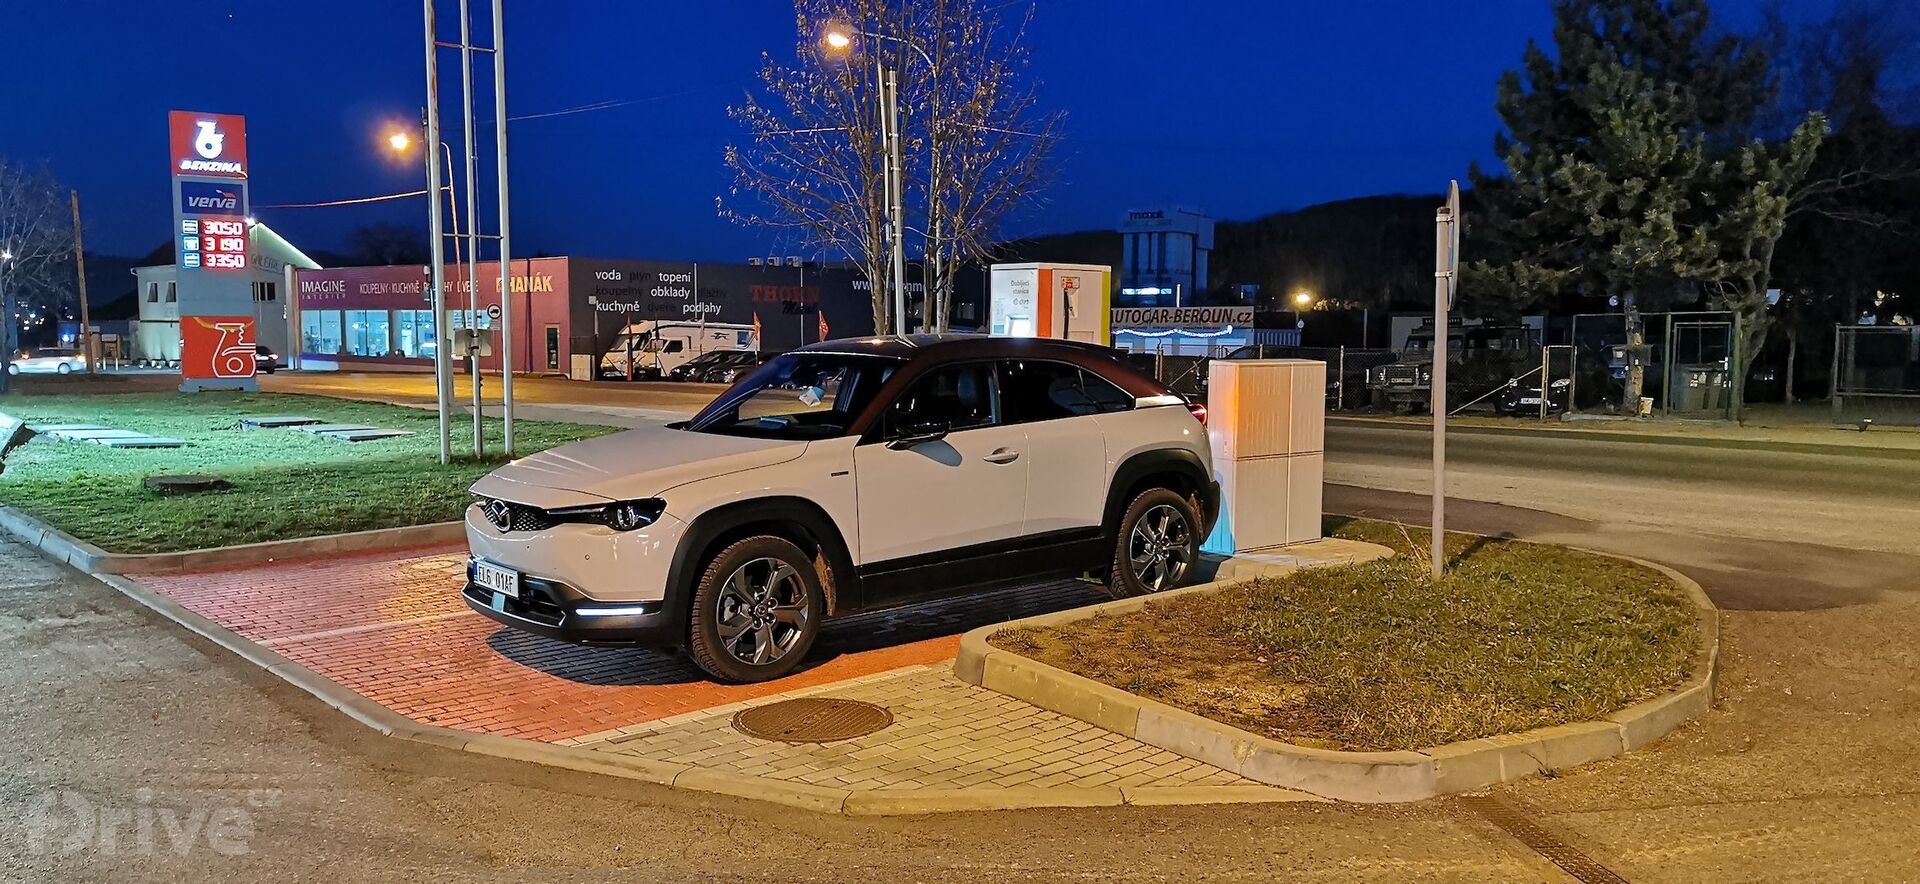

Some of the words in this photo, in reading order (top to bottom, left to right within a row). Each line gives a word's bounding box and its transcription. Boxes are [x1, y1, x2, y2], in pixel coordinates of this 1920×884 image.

[180, 160, 242, 173] BENZINA
[188, 195, 237, 209] verva
[204, 221, 243, 235] 3050
[206, 253, 245, 268] 3350
[595, 269, 622, 280] voda
[659, 271, 692, 284] topení
[301, 280, 346, 293] IMAGINE
[650, 286, 691, 300] obklady
[596, 300, 640, 314] kuchyně
[683, 302, 722, 316] podlahy
[478, 566, 492, 585] EL6
